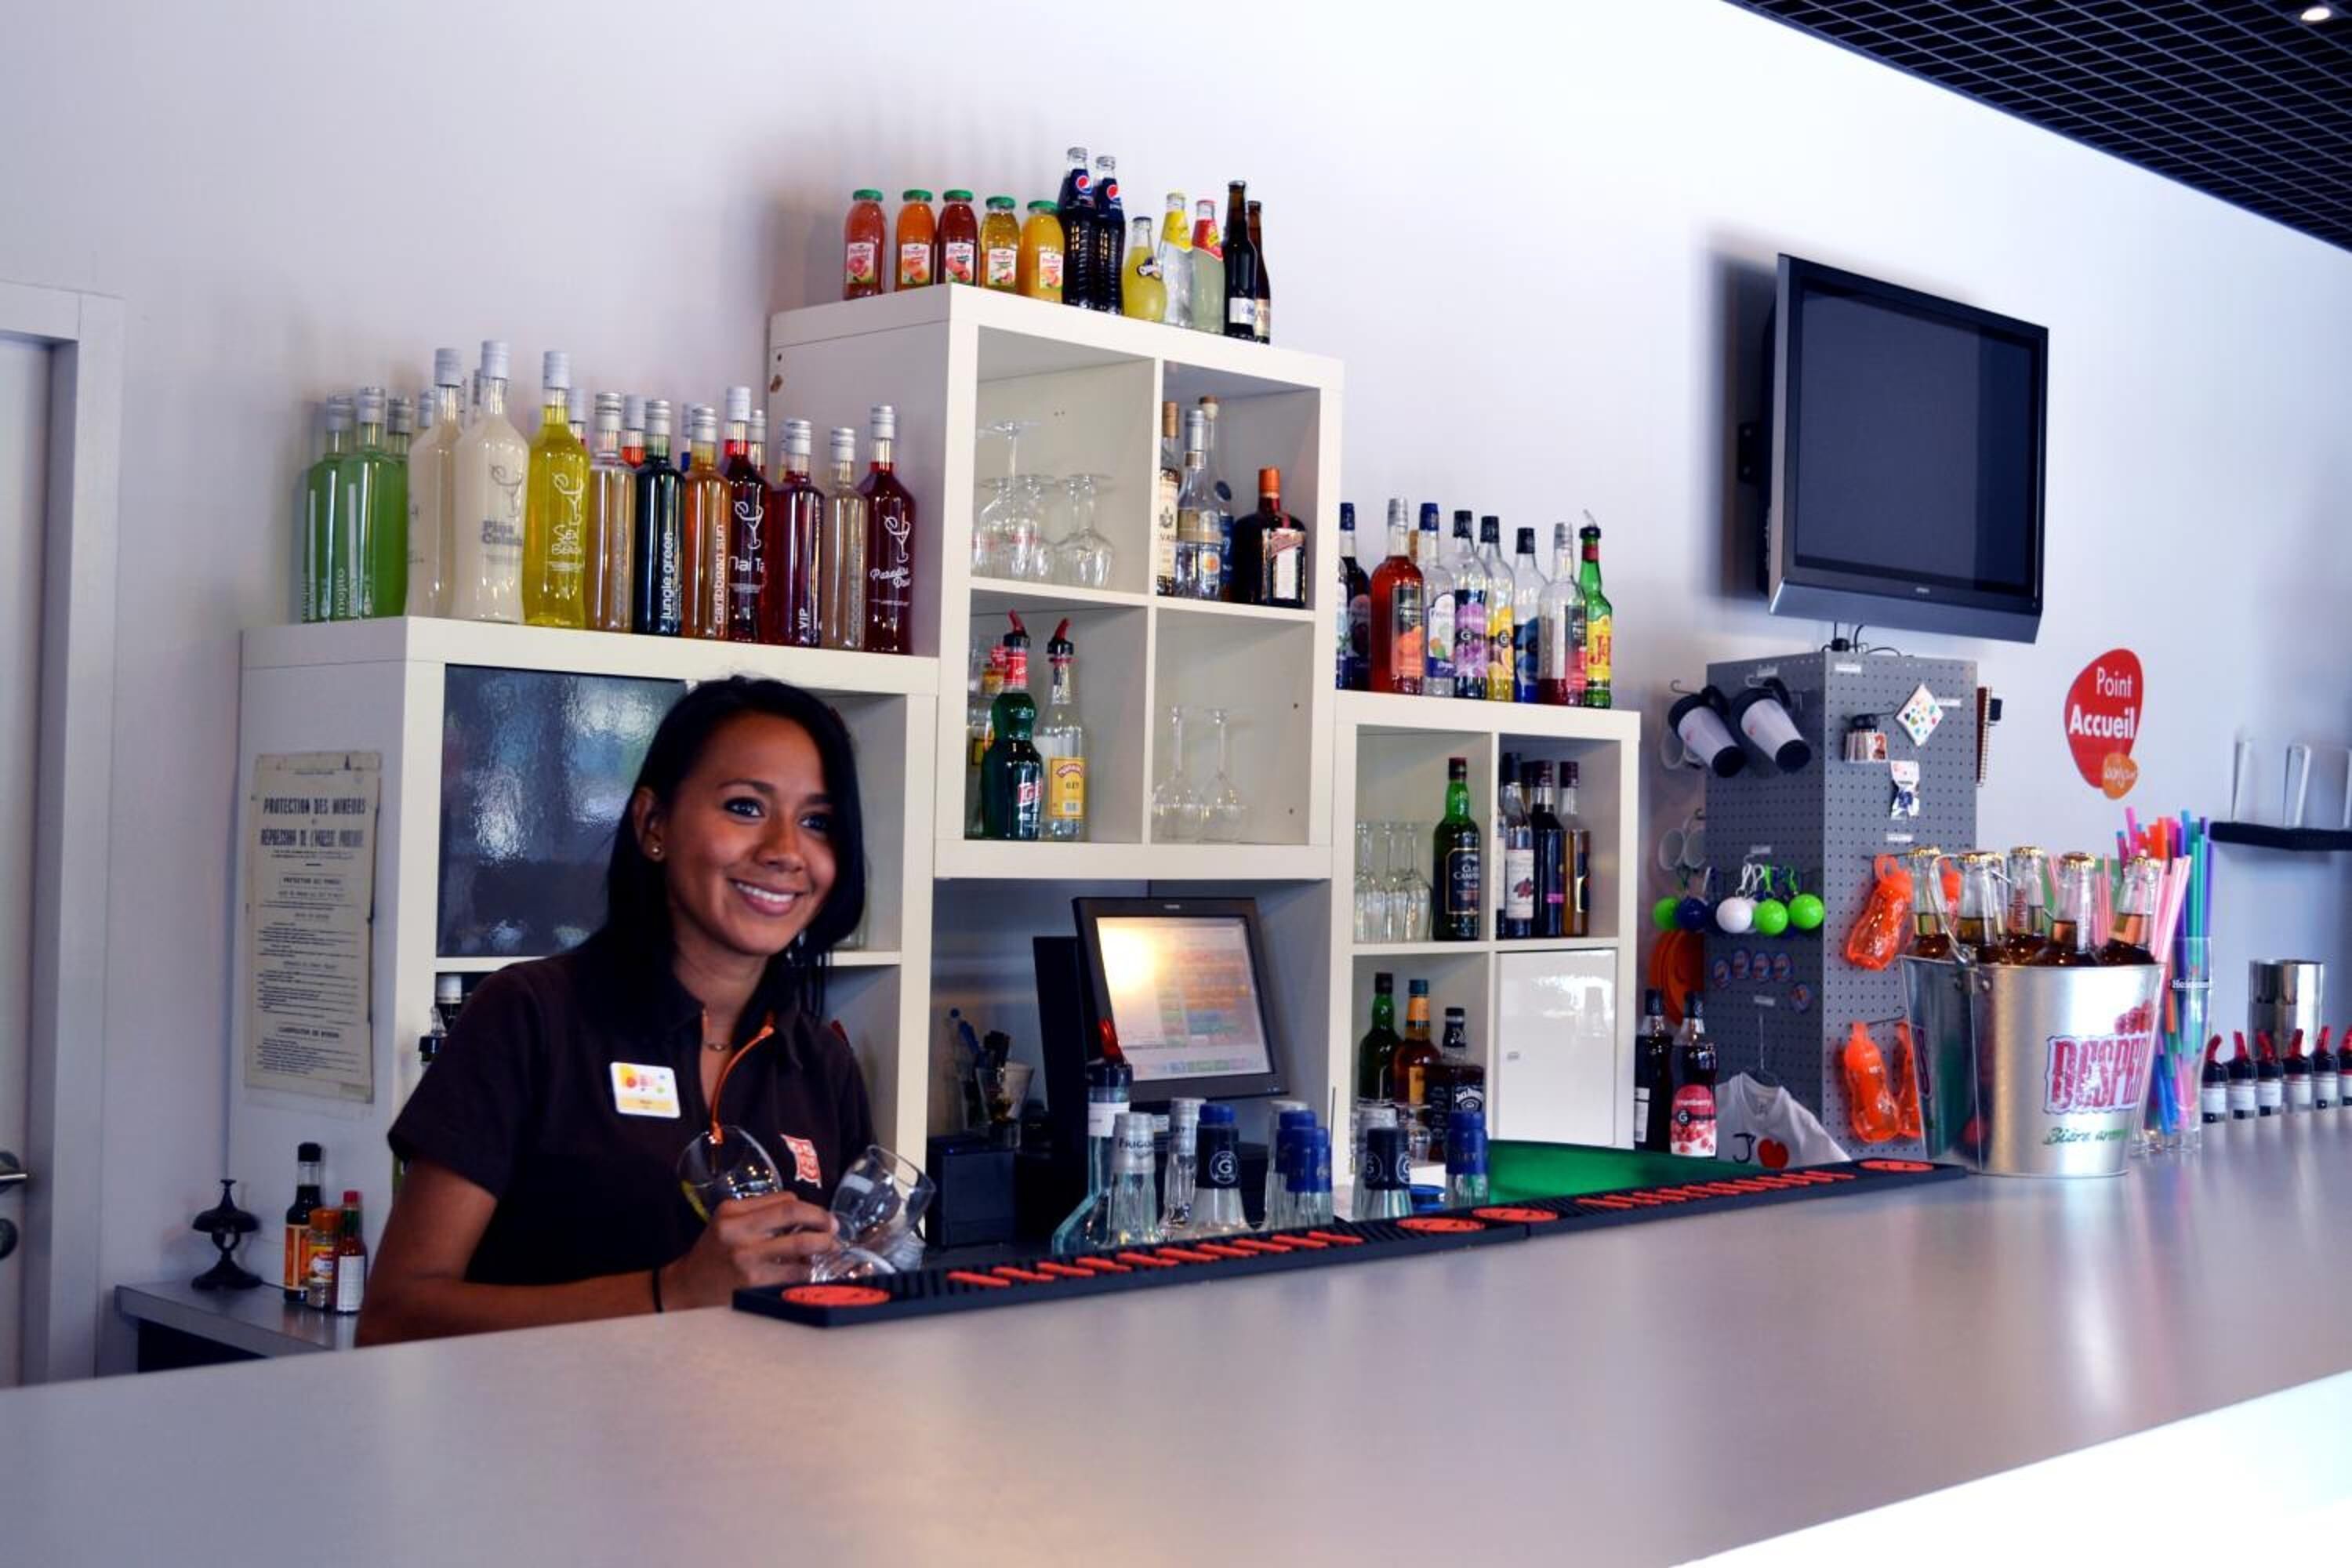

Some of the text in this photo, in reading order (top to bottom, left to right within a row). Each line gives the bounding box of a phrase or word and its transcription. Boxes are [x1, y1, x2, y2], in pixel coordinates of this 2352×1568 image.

[715, 524, 726, 550] sun
[338, 567, 347, 616] mojito
[660, 531, 674, 620] jungle green
[2096, 666, 2132, 698] Point
[2069, 703, 2136, 739] Accueil
[263, 797, 365, 815] PROTECTION DES MINEURS
[1218, 1159, 1232, 1174] G
